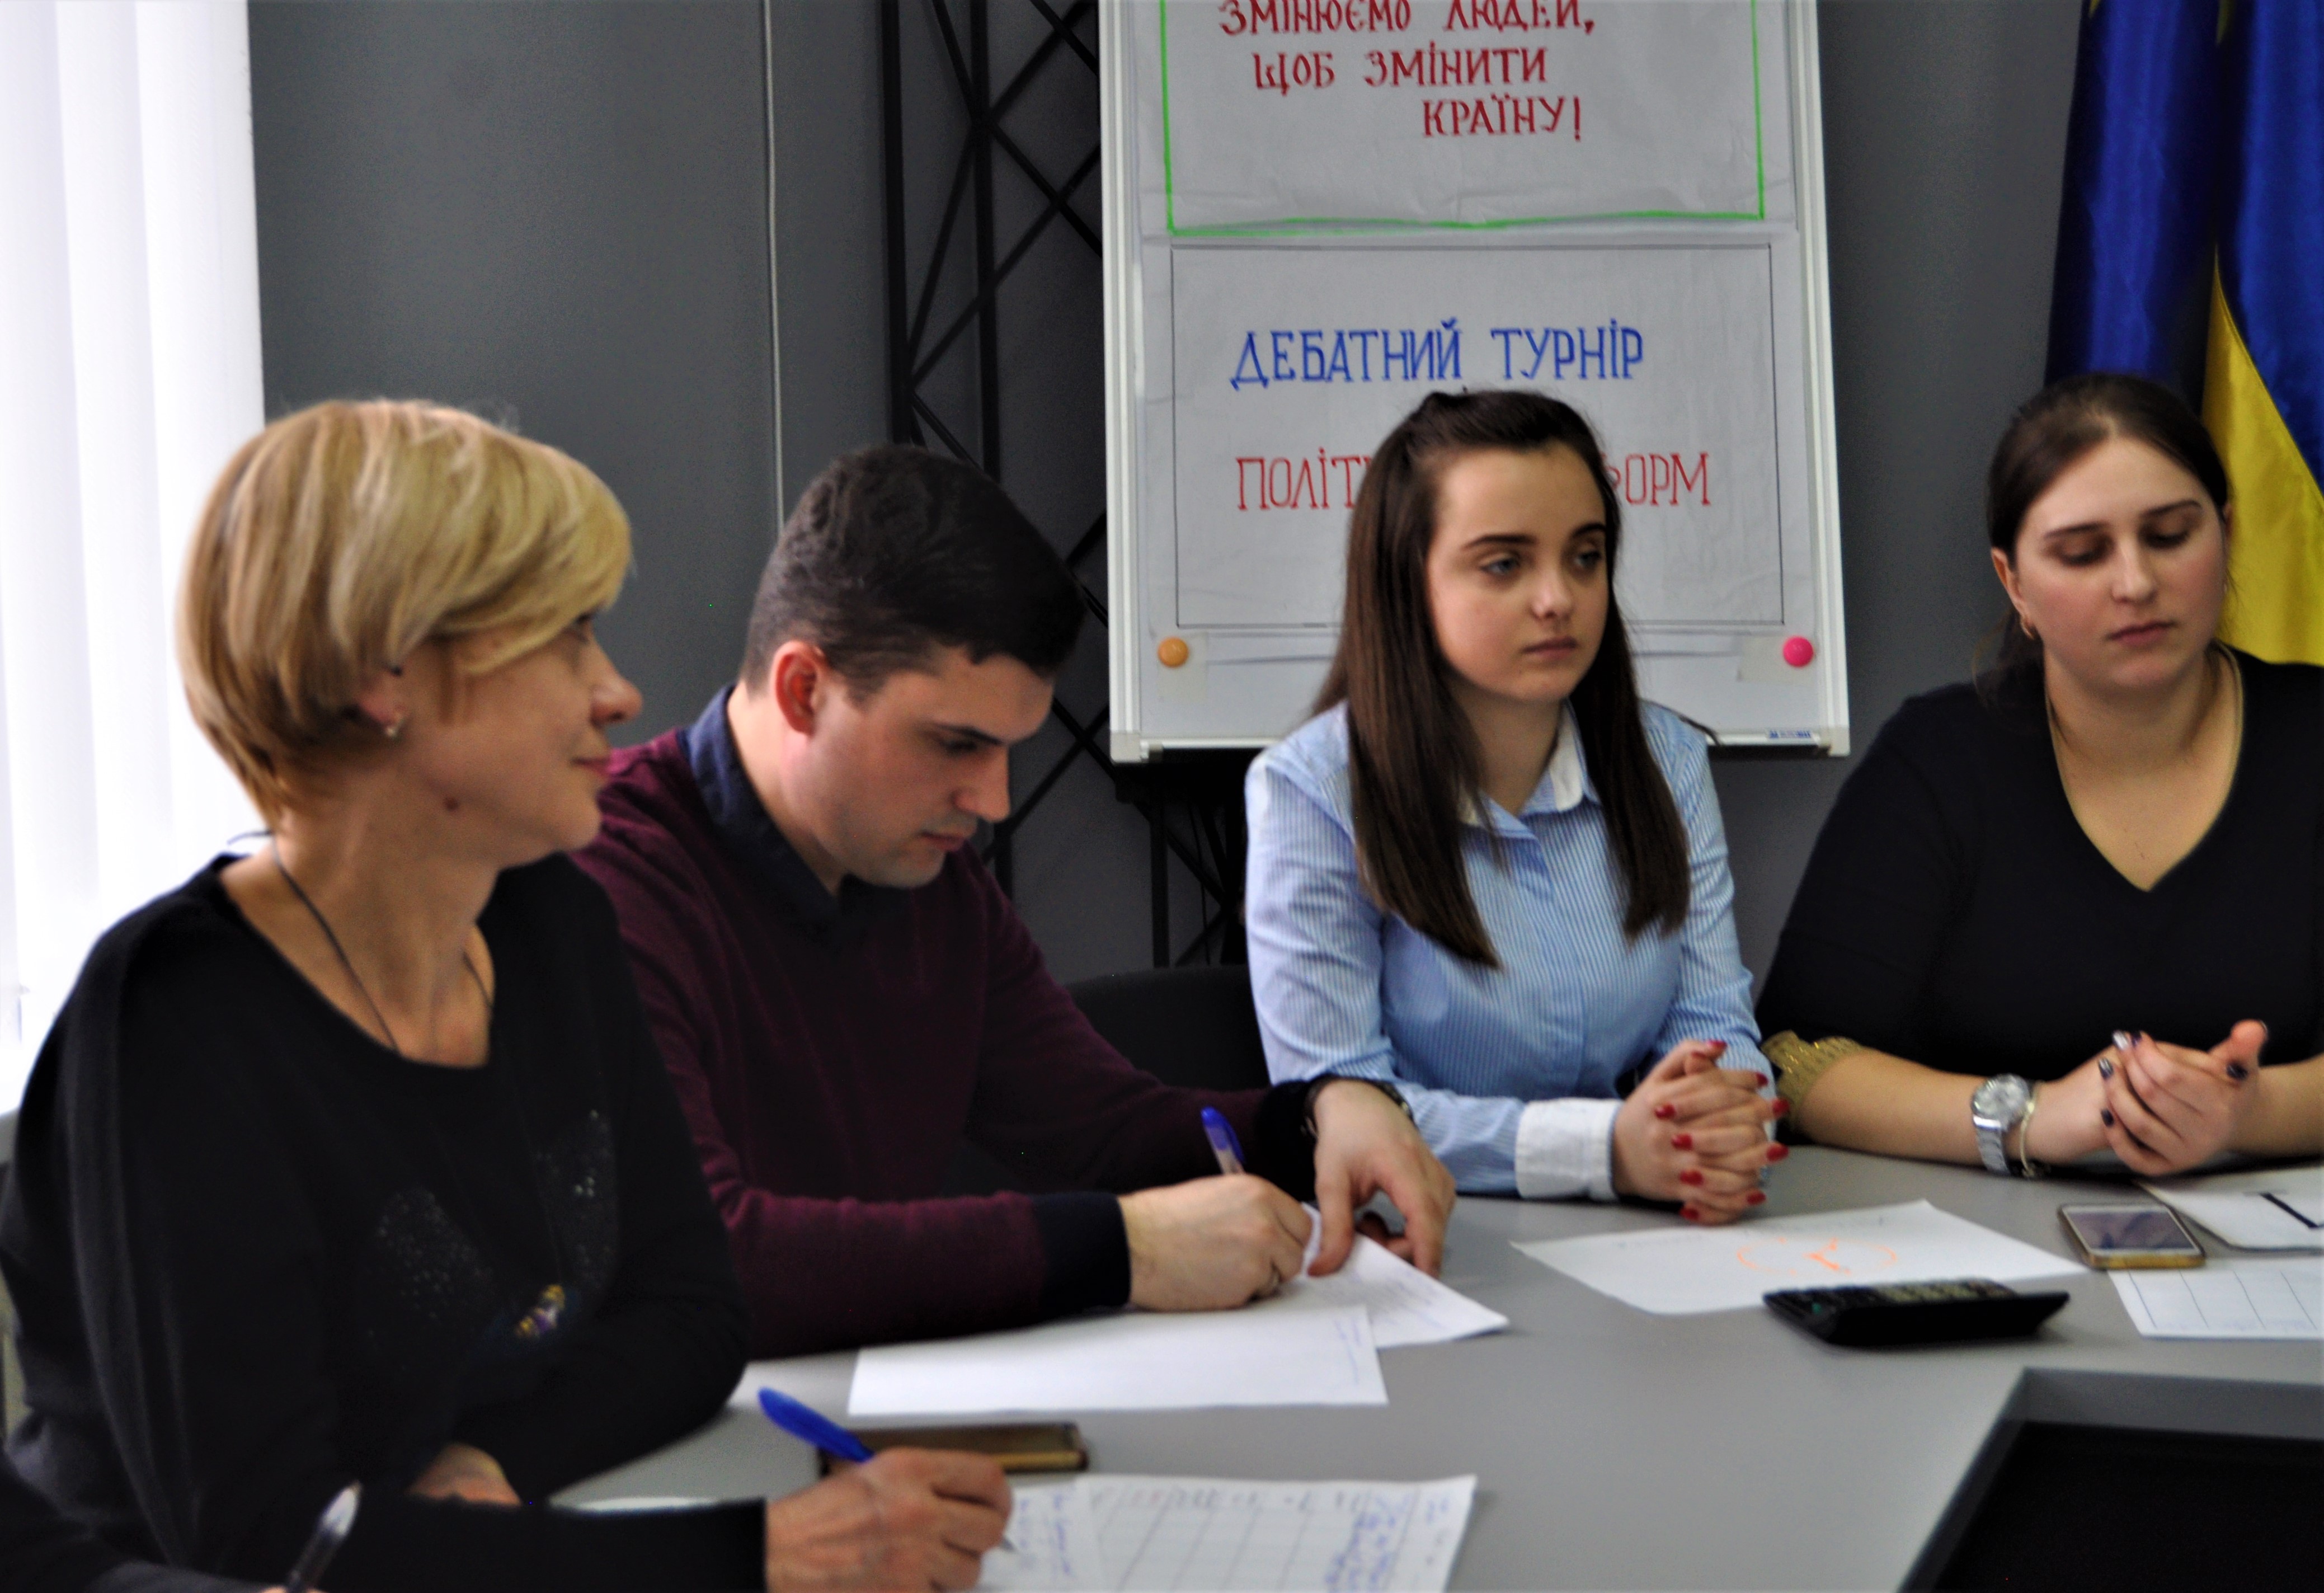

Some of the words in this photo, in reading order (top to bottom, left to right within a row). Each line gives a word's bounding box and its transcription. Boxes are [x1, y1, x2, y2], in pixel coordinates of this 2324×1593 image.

[1219, 0, 1412, 36] ЗМІНЮЄМО
[1252, 51, 1336, 96] ЩОБ
[1363, 40, 1547, 87] ЗМІНИТИ
[1422, 93, 1582, 141] КРАЇНУ!
[1229, 316, 1463, 391] ДЕБАТНИЙ
[1489, 317, 1644, 380] ТУРНІР
[1235, 447, 1373, 511] ПОЛІТ
